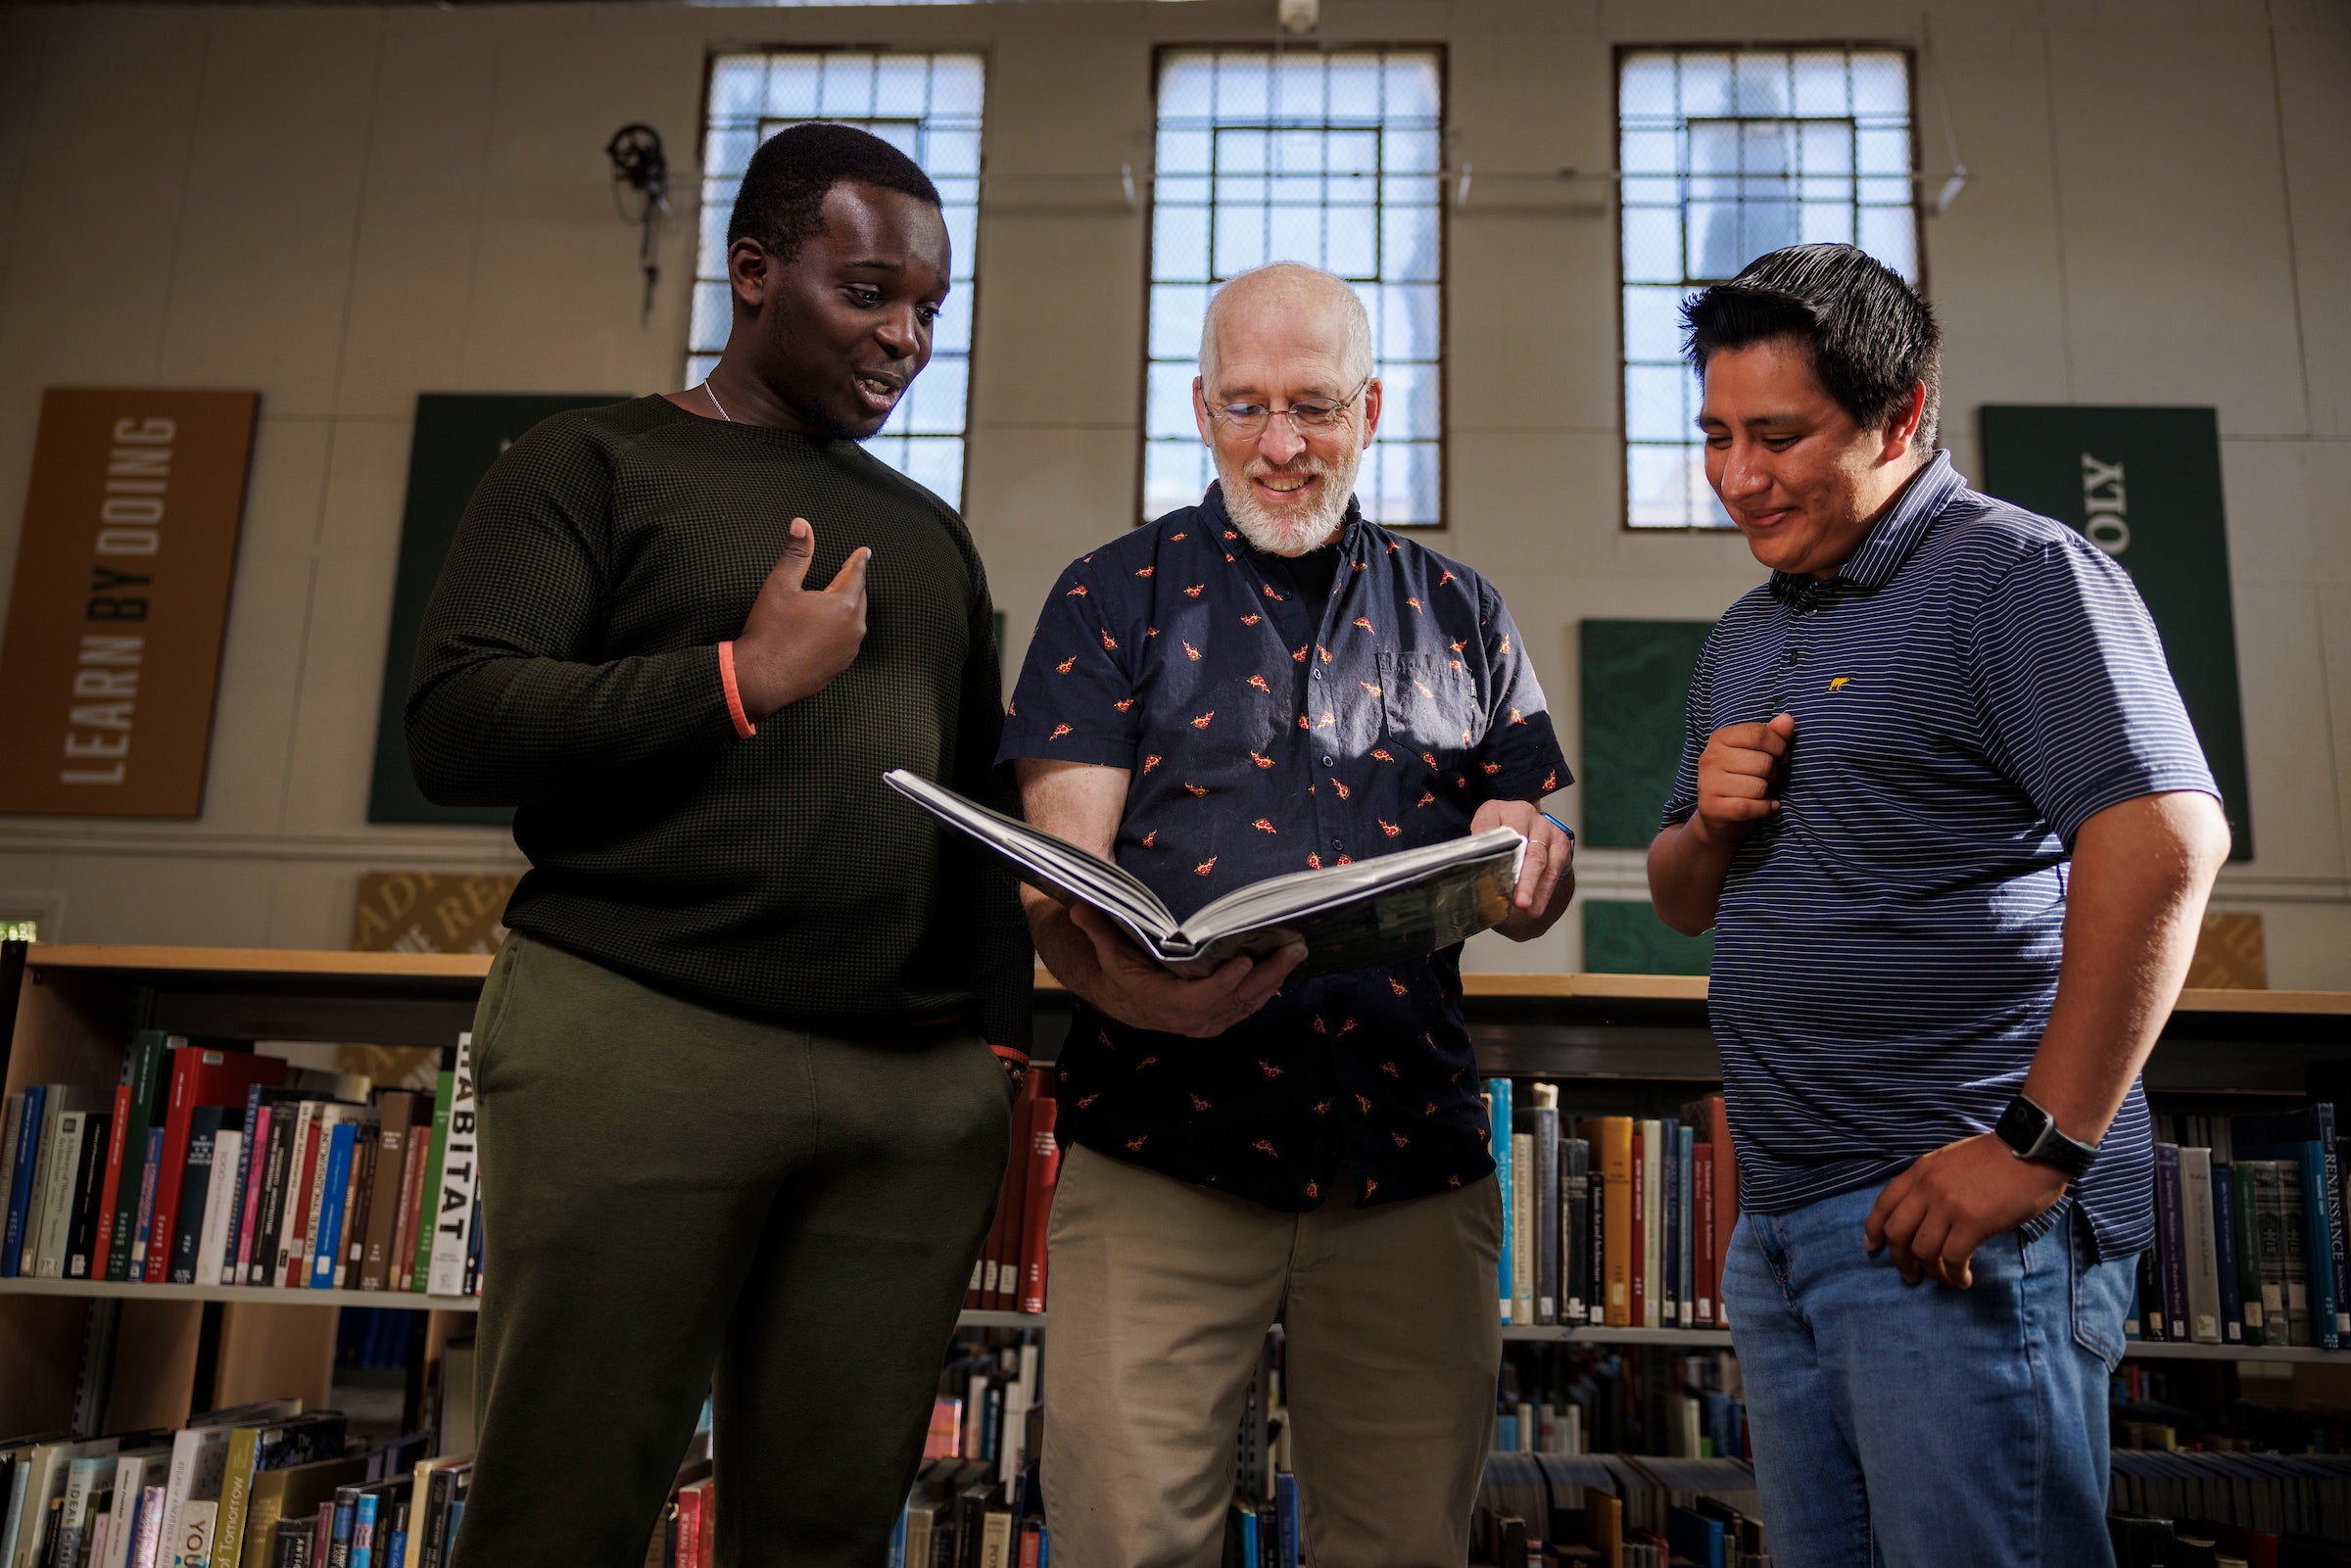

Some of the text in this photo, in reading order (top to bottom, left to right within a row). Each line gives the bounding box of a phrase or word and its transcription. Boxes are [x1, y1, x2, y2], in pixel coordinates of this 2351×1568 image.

[2081, 451, 2133, 558] OLY
[60, 417, 177, 784] LEARN BY DOING
[239, 1092, 260, 1176] VISIONARY
[1703, 1160, 1711, 1191] Dictionary
[2167, 1211, 2177, 1243] Wonders
[2322, 1152, 2346, 1261] RENAISSANCE
[2335, 1263, 2346, 1304] Architecture
[1593, 1240, 1602, 1281] Architecture
[2171, 1262, 2181, 1290] Modern
[2173, 1292, 2182, 1314] World
[66, 1482, 81, 1526] IDEAL
[217, 1475, 244, 1554] Tomorrow
[183, 1518, 206, 1567] YOU
